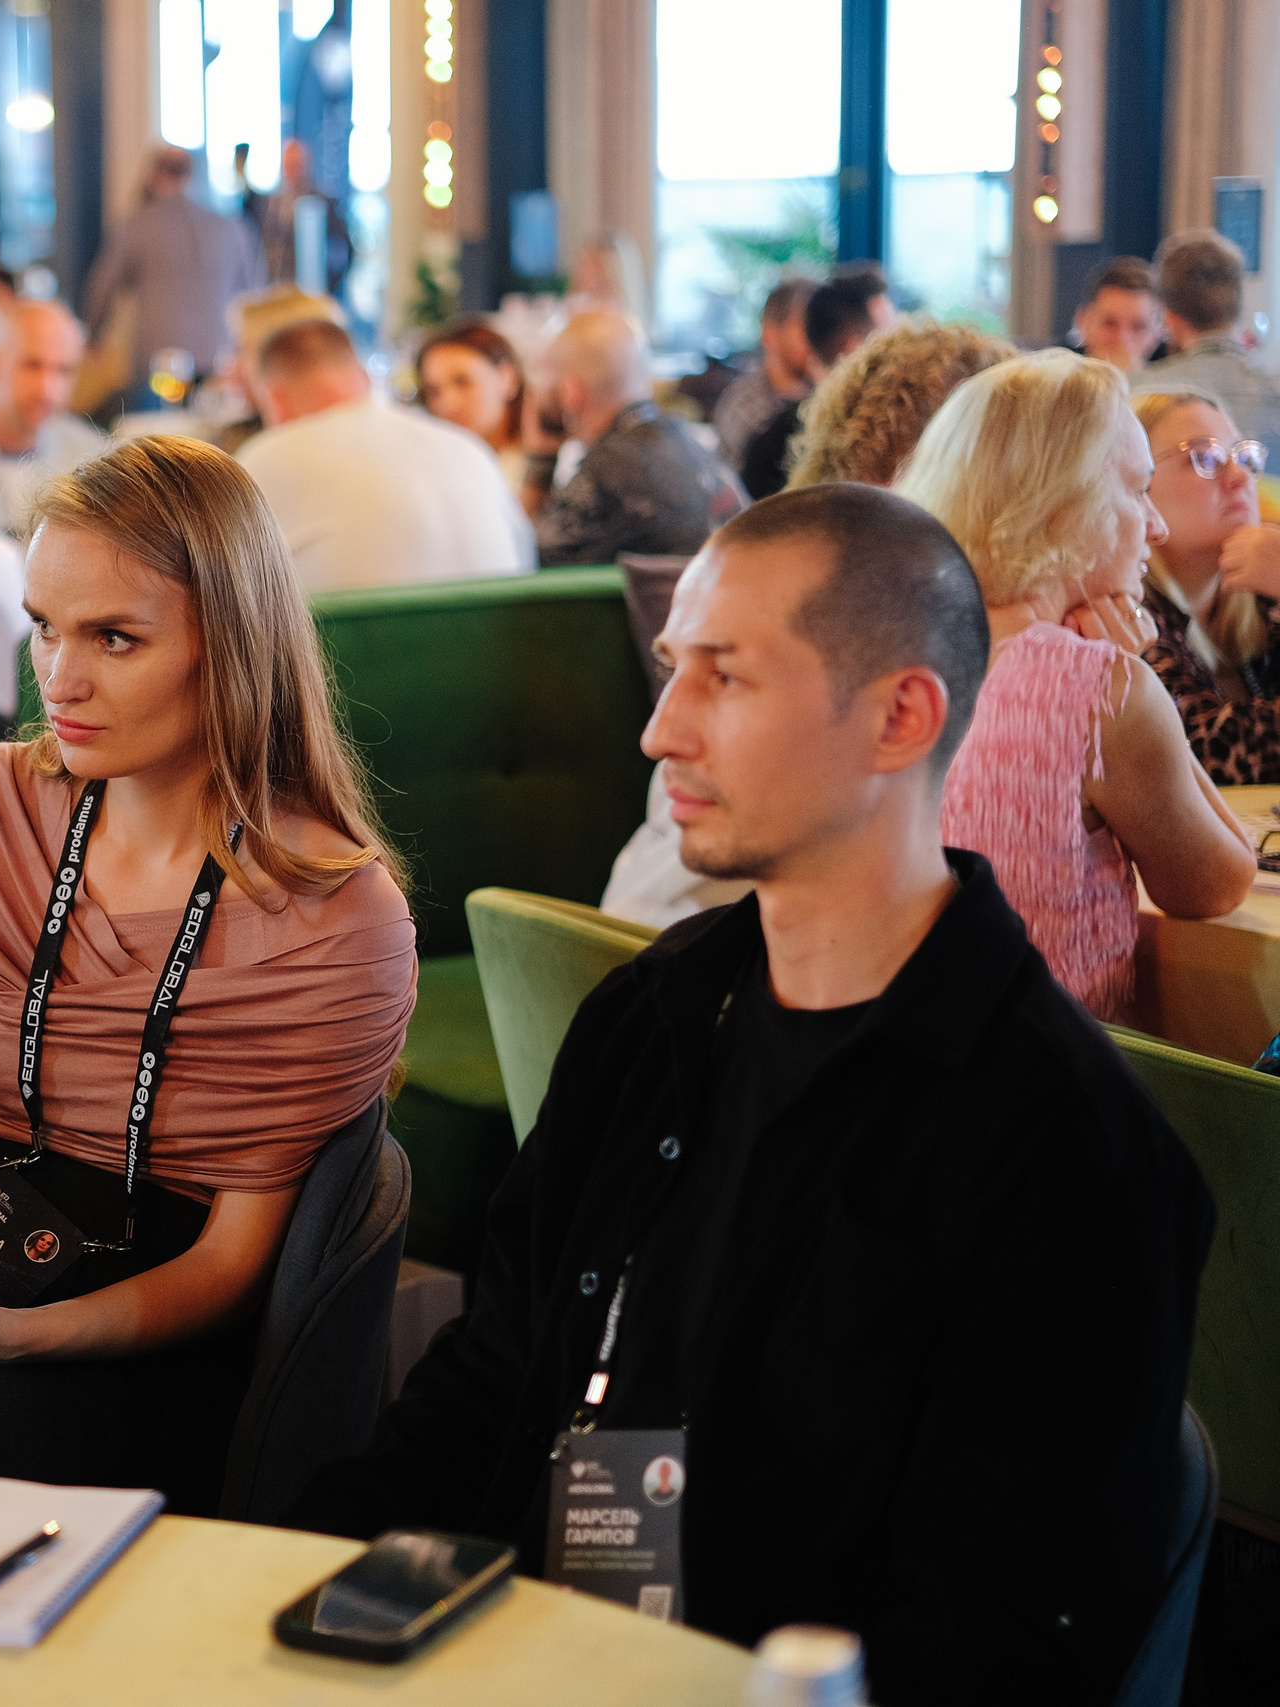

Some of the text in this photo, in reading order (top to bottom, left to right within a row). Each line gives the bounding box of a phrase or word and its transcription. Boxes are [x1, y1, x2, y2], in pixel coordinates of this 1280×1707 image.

[68, 795, 94, 863] prodamus
[153, 907, 204, 1016] EDGLOBAL
[22, 969, 49, 1082] EDGLOBAL
[127, 1124, 139, 1195] prodamus
[565, 1527, 637, 1545] ГАРИПОВ
[567, 1507, 642, 1526] МАРСЕЛЬ
